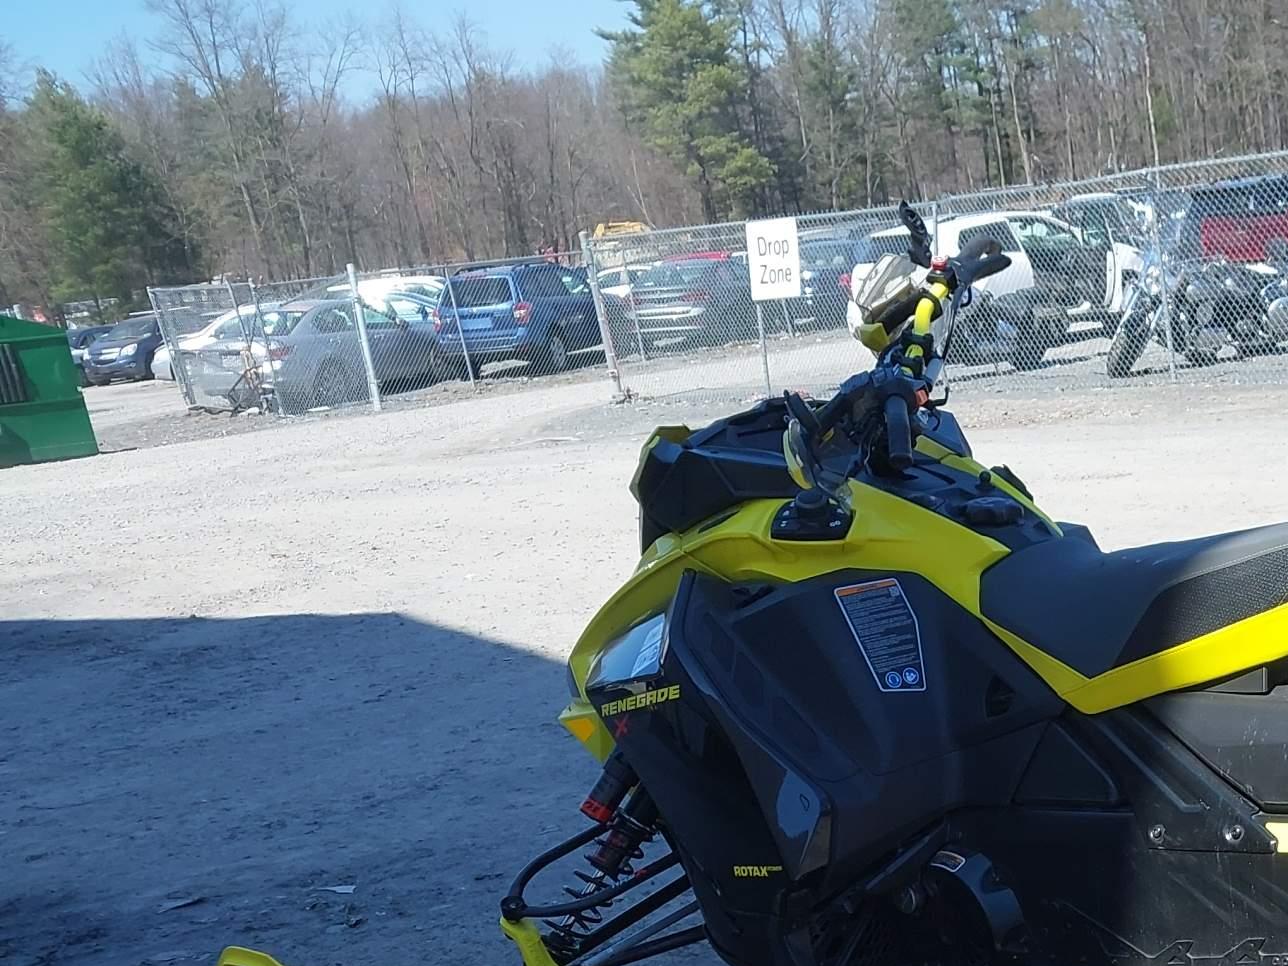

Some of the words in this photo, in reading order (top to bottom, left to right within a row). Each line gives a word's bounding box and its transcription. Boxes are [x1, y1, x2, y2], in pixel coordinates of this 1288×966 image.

[757, 236, 789, 258] Drop
[760, 264, 792, 285] Zone
[601, 685, 680, 717] RENEGADE
[733, 865, 768, 877] ROTAX
